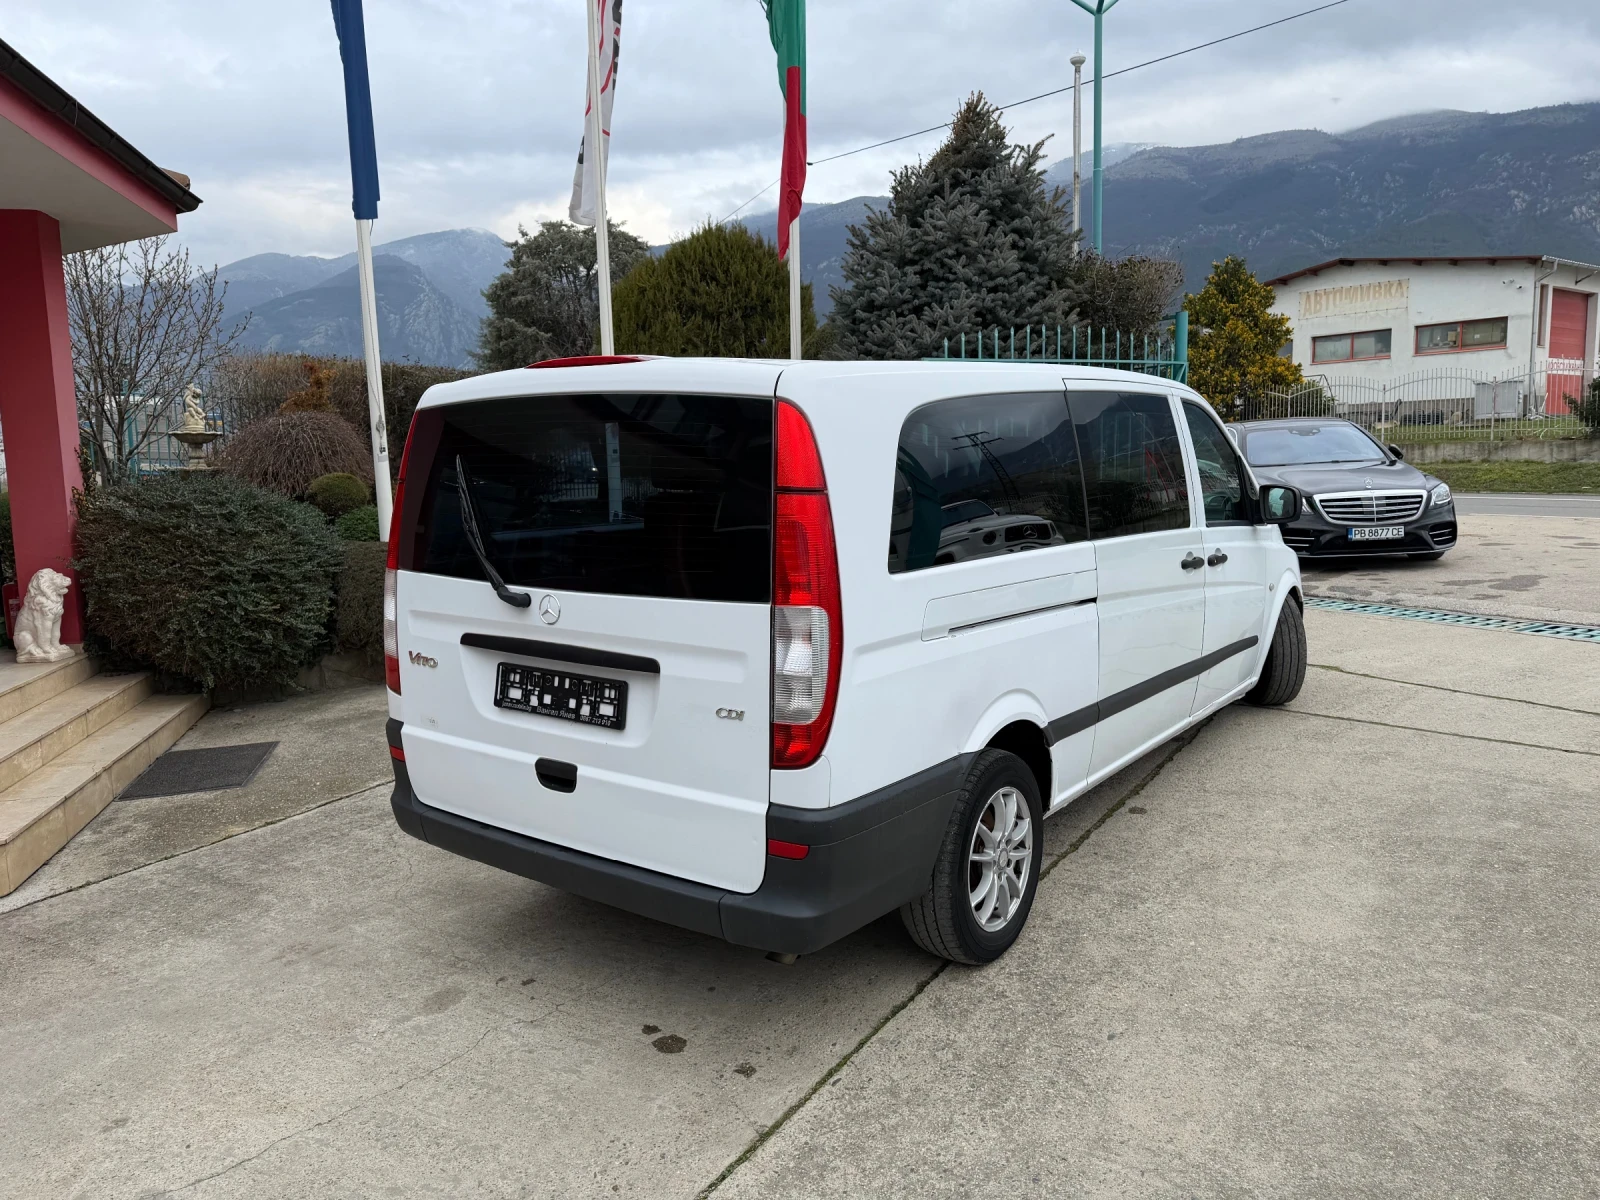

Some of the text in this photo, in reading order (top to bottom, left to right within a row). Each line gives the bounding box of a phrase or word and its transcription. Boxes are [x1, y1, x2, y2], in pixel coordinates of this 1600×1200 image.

[1303, 282, 1405, 317] АВТОМИВКА
[1353, 529, 1367, 538] PB
[1368, 528, 1390, 537] 8877
[1391, 527, 1403, 536] CE
[715, 707, 746, 721] CDI
